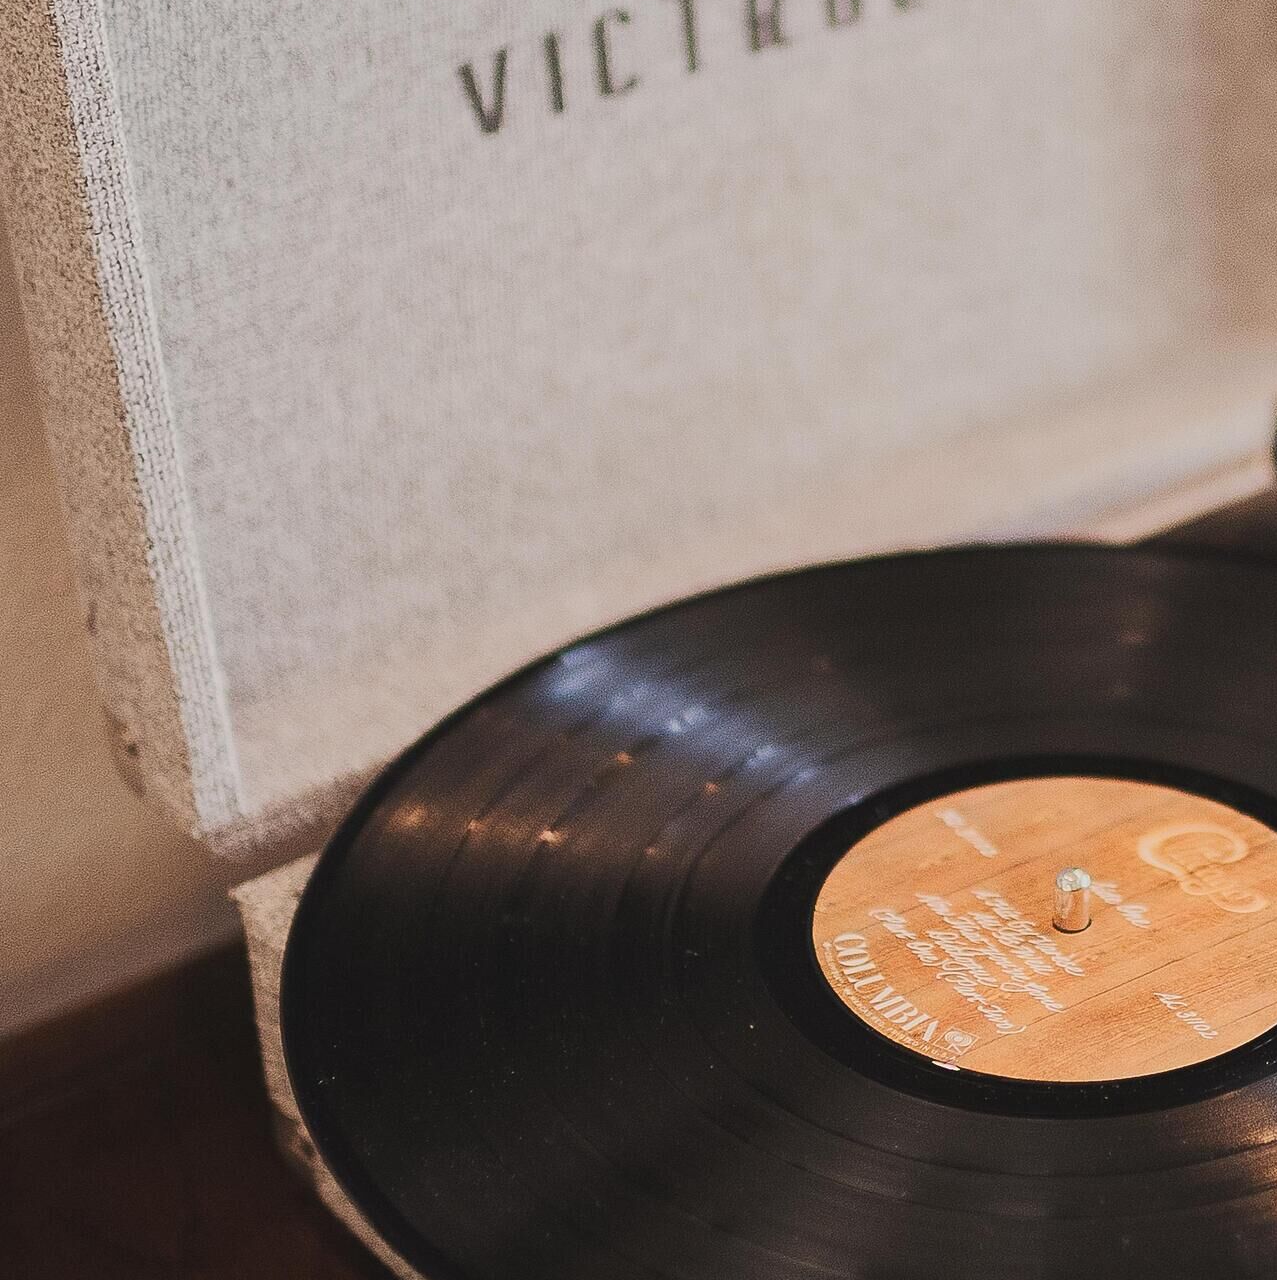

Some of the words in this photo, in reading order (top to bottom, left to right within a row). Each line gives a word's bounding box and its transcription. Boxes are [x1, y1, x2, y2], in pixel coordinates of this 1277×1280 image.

[1117, 904, 1151, 928] One
[834, 933, 941, 1040] COLUMBIA
[868, 907, 917, 941] (Part
[905, 940, 946, 967] One)
[936, 971, 988, 1005] (Part
[977, 1002, 1027, 1034] Two)
[925, 929, 999, 988] Dialogue
[1176, 1009, 1218, 1039] 31102
